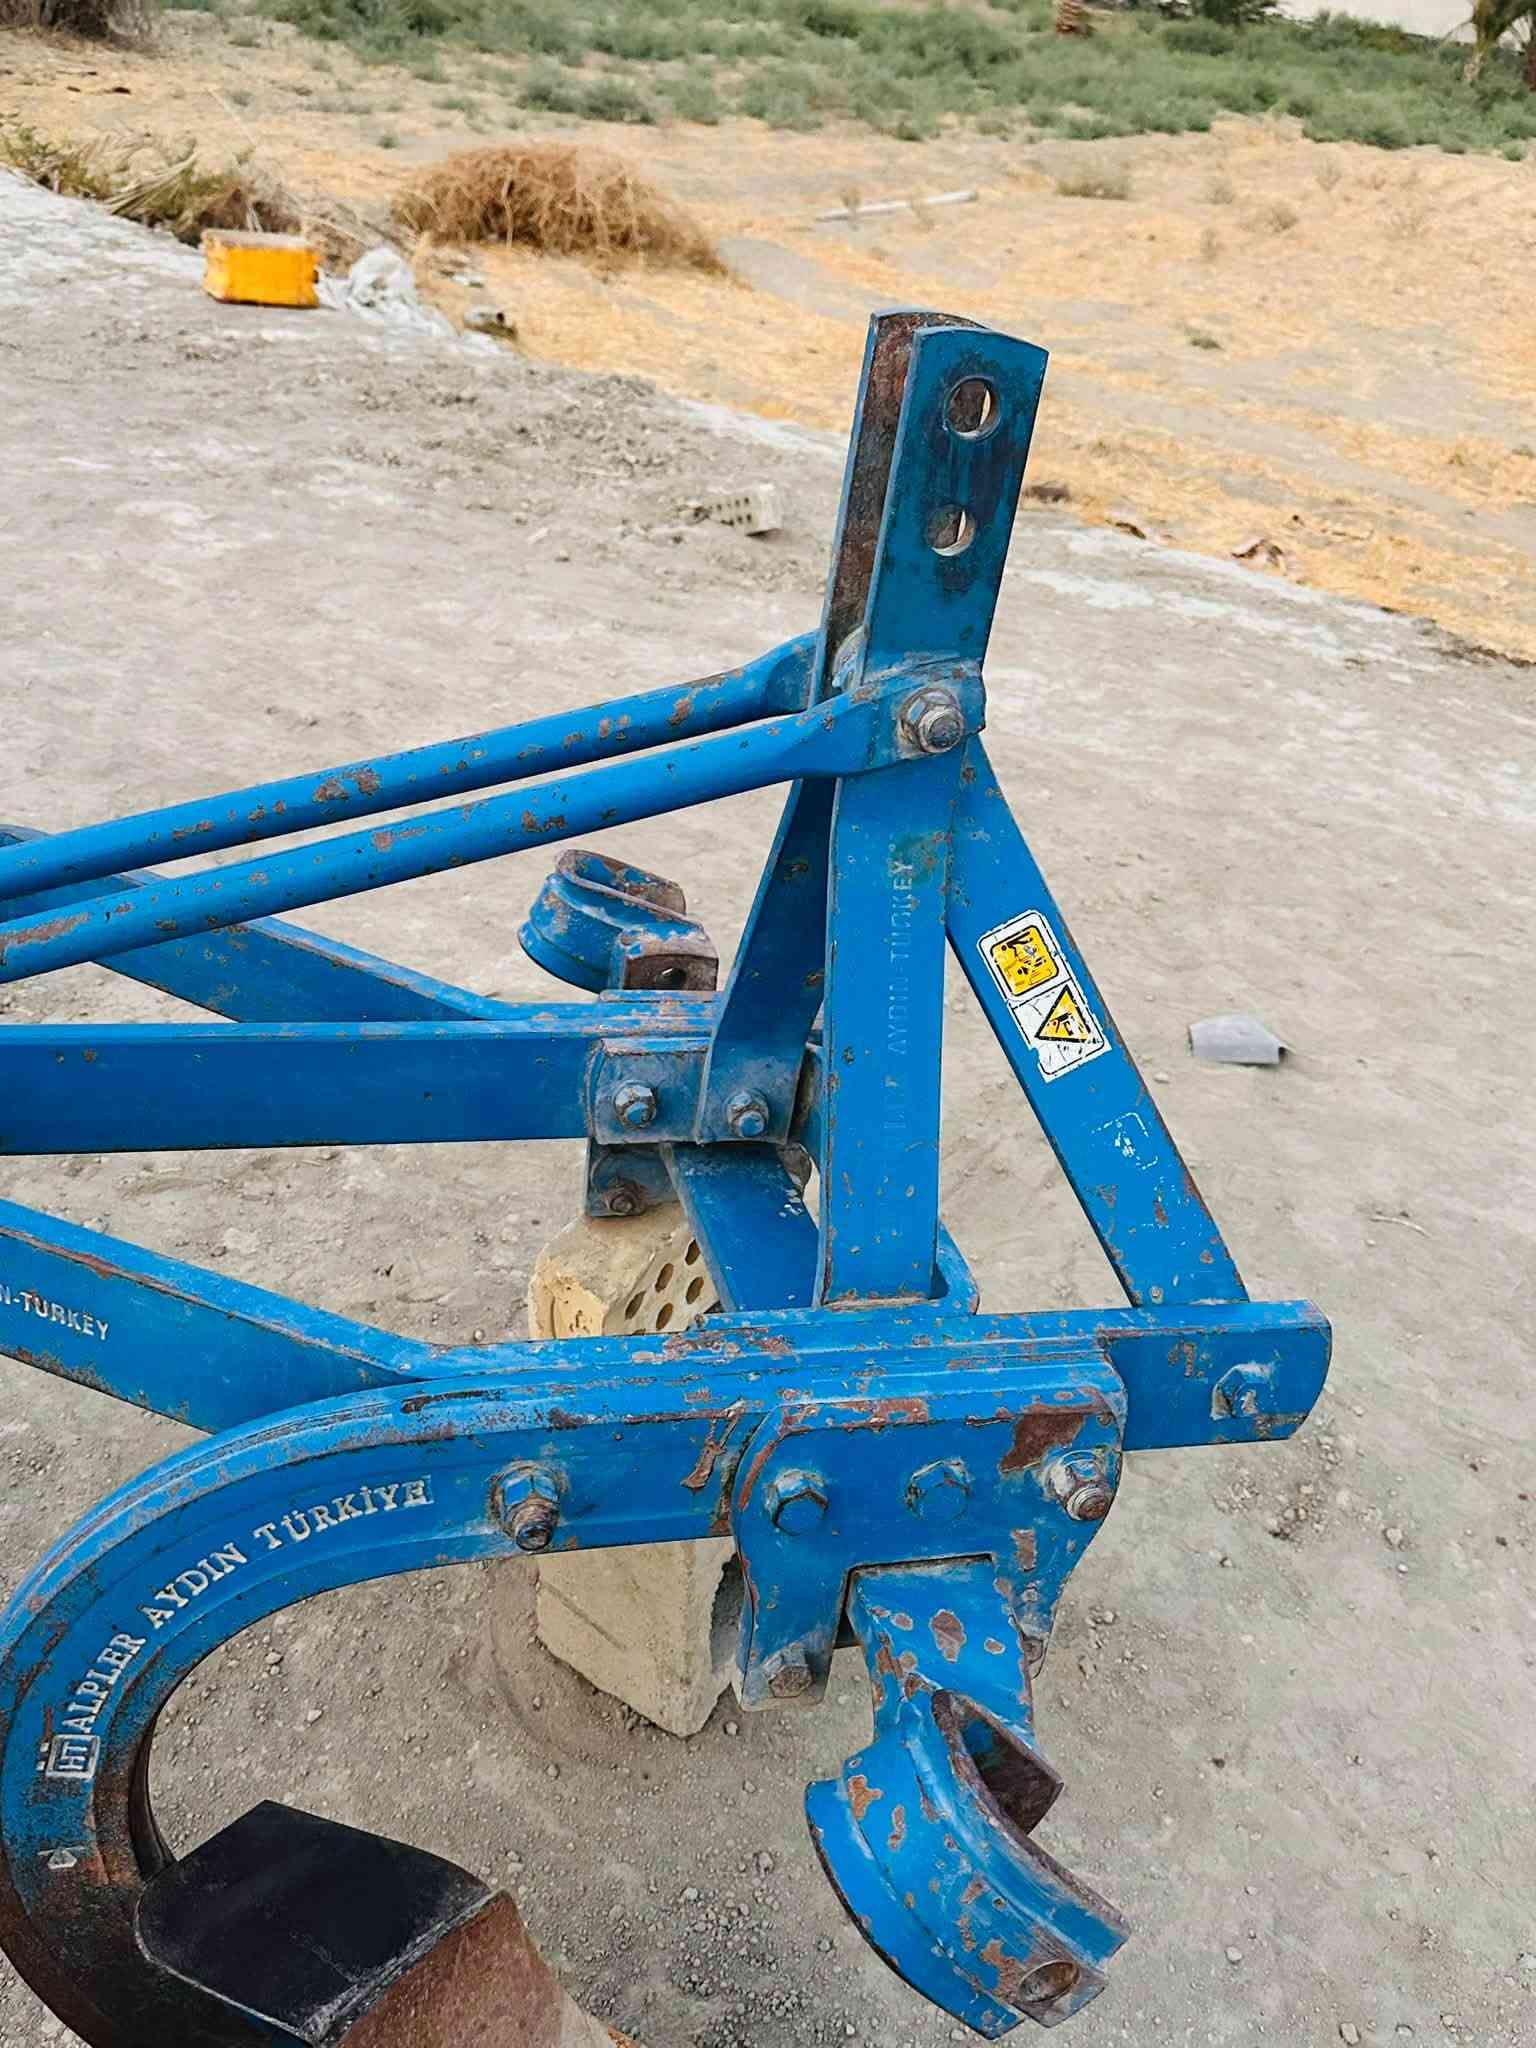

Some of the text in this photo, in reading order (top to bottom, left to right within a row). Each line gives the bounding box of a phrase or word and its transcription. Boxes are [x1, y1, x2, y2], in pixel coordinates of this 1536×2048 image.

[61, 1633, 146, 1735] ALPLER
[138, 1542, 248, 1629] AYDIN
[253, 1475, 434, 1550] TÜRKİYE
